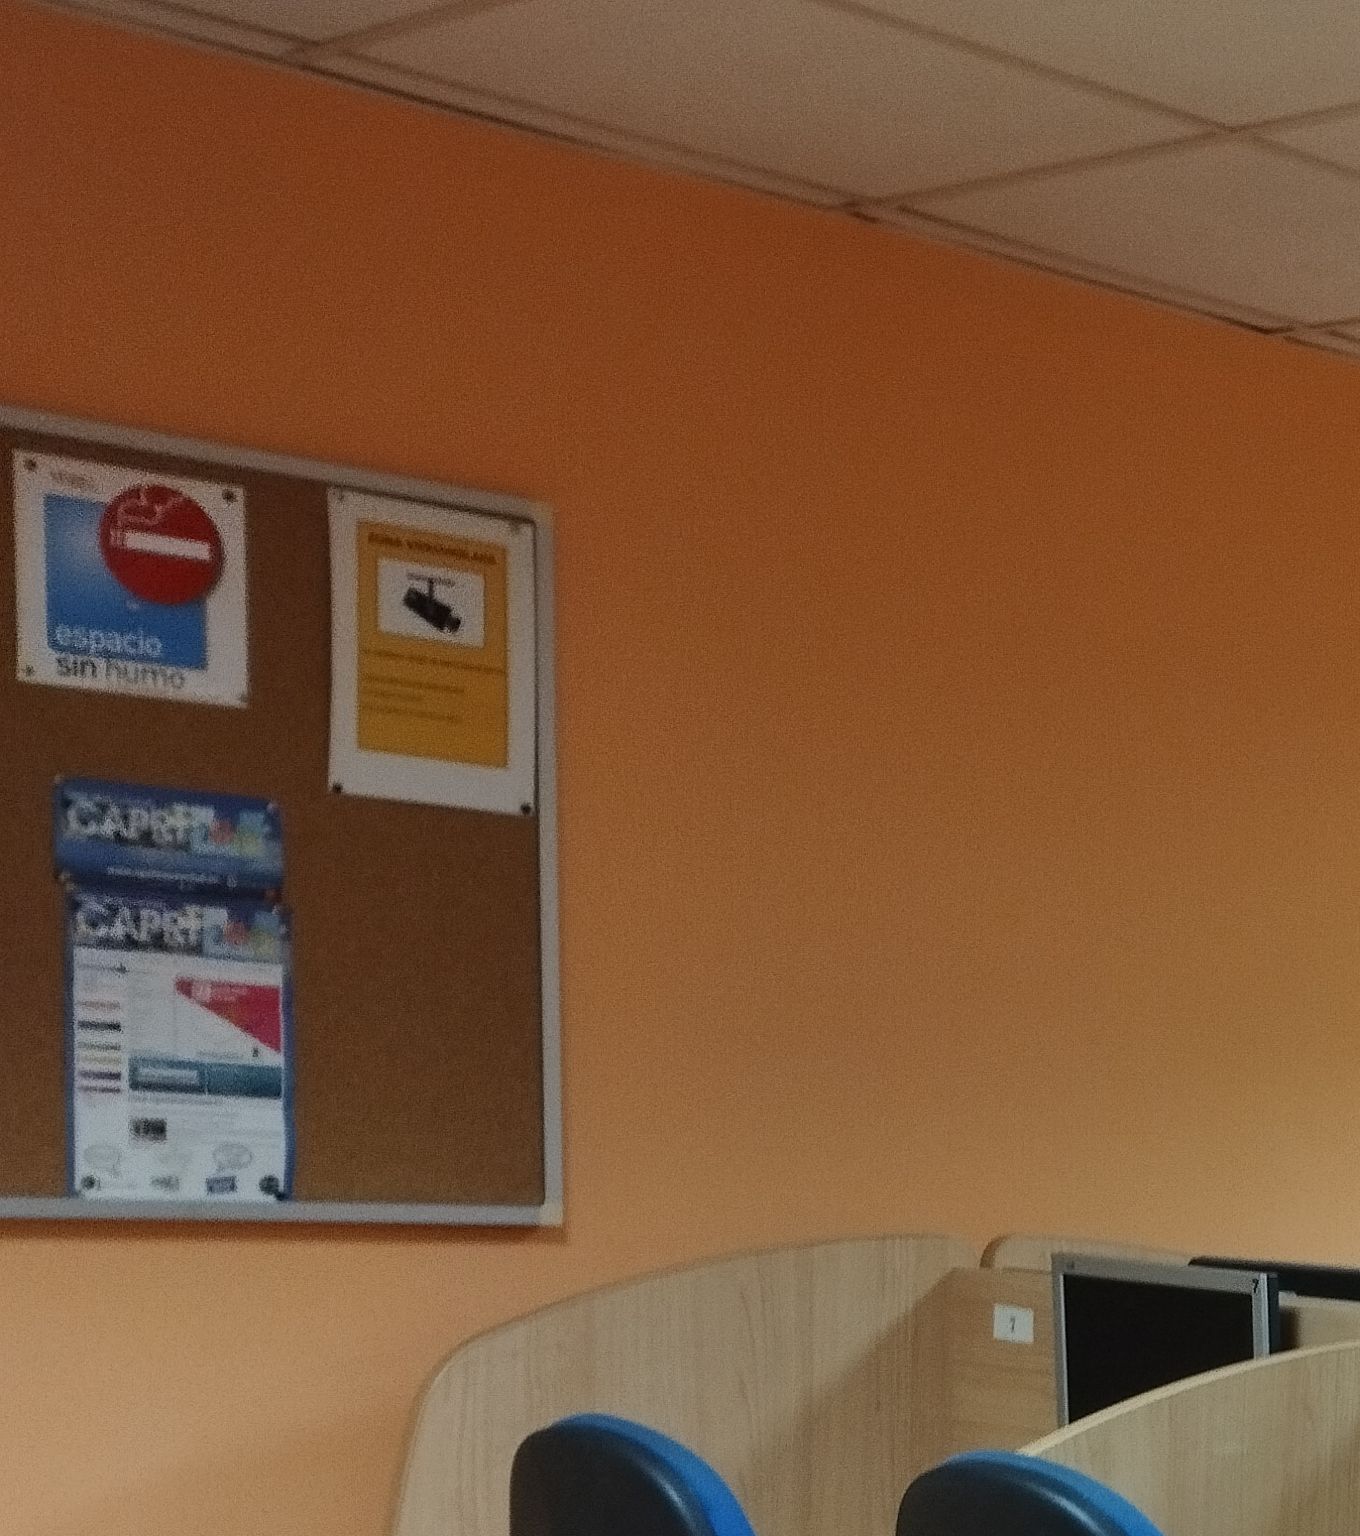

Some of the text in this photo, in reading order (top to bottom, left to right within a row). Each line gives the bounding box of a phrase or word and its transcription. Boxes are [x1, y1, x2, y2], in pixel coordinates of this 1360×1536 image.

[55, 623, 164, 658] espacio
[56, 656, 186, 690] sin humo
[1252, 1278, 1260, 1294] 7
